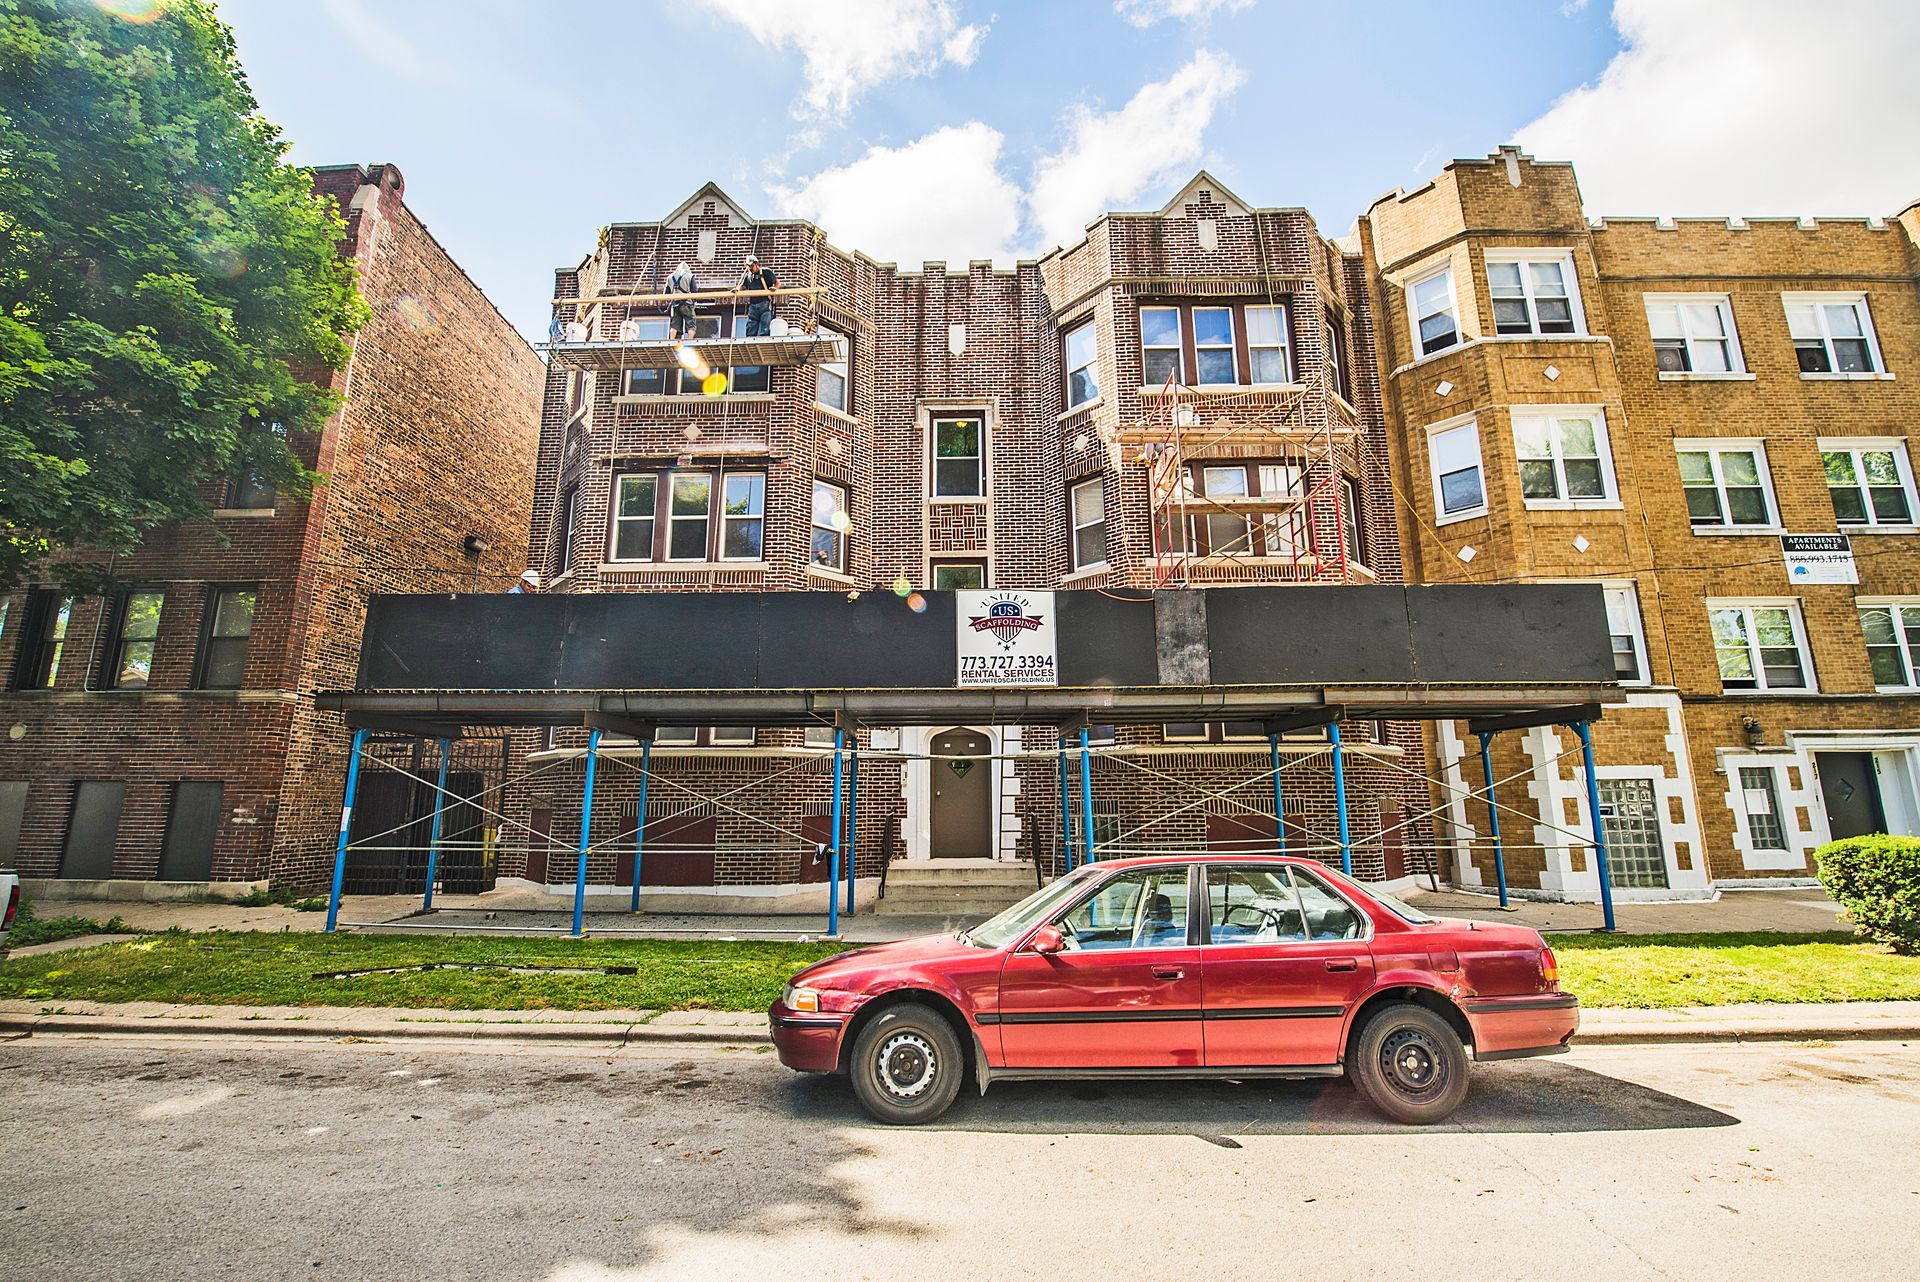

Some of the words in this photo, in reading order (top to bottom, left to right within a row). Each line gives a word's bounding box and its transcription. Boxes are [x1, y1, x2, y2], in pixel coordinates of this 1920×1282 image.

[981, 593, 1029, 607] UNITED
[998, 606, 1014, 616] US
[975, 619, 1037, 630] SCAFFOLDING
[961, 655, 1054, 669] 773.727.3394
[961, 670, 1000, 678] RENTAL
[1003, 669, 1055, 677] SERVICES
